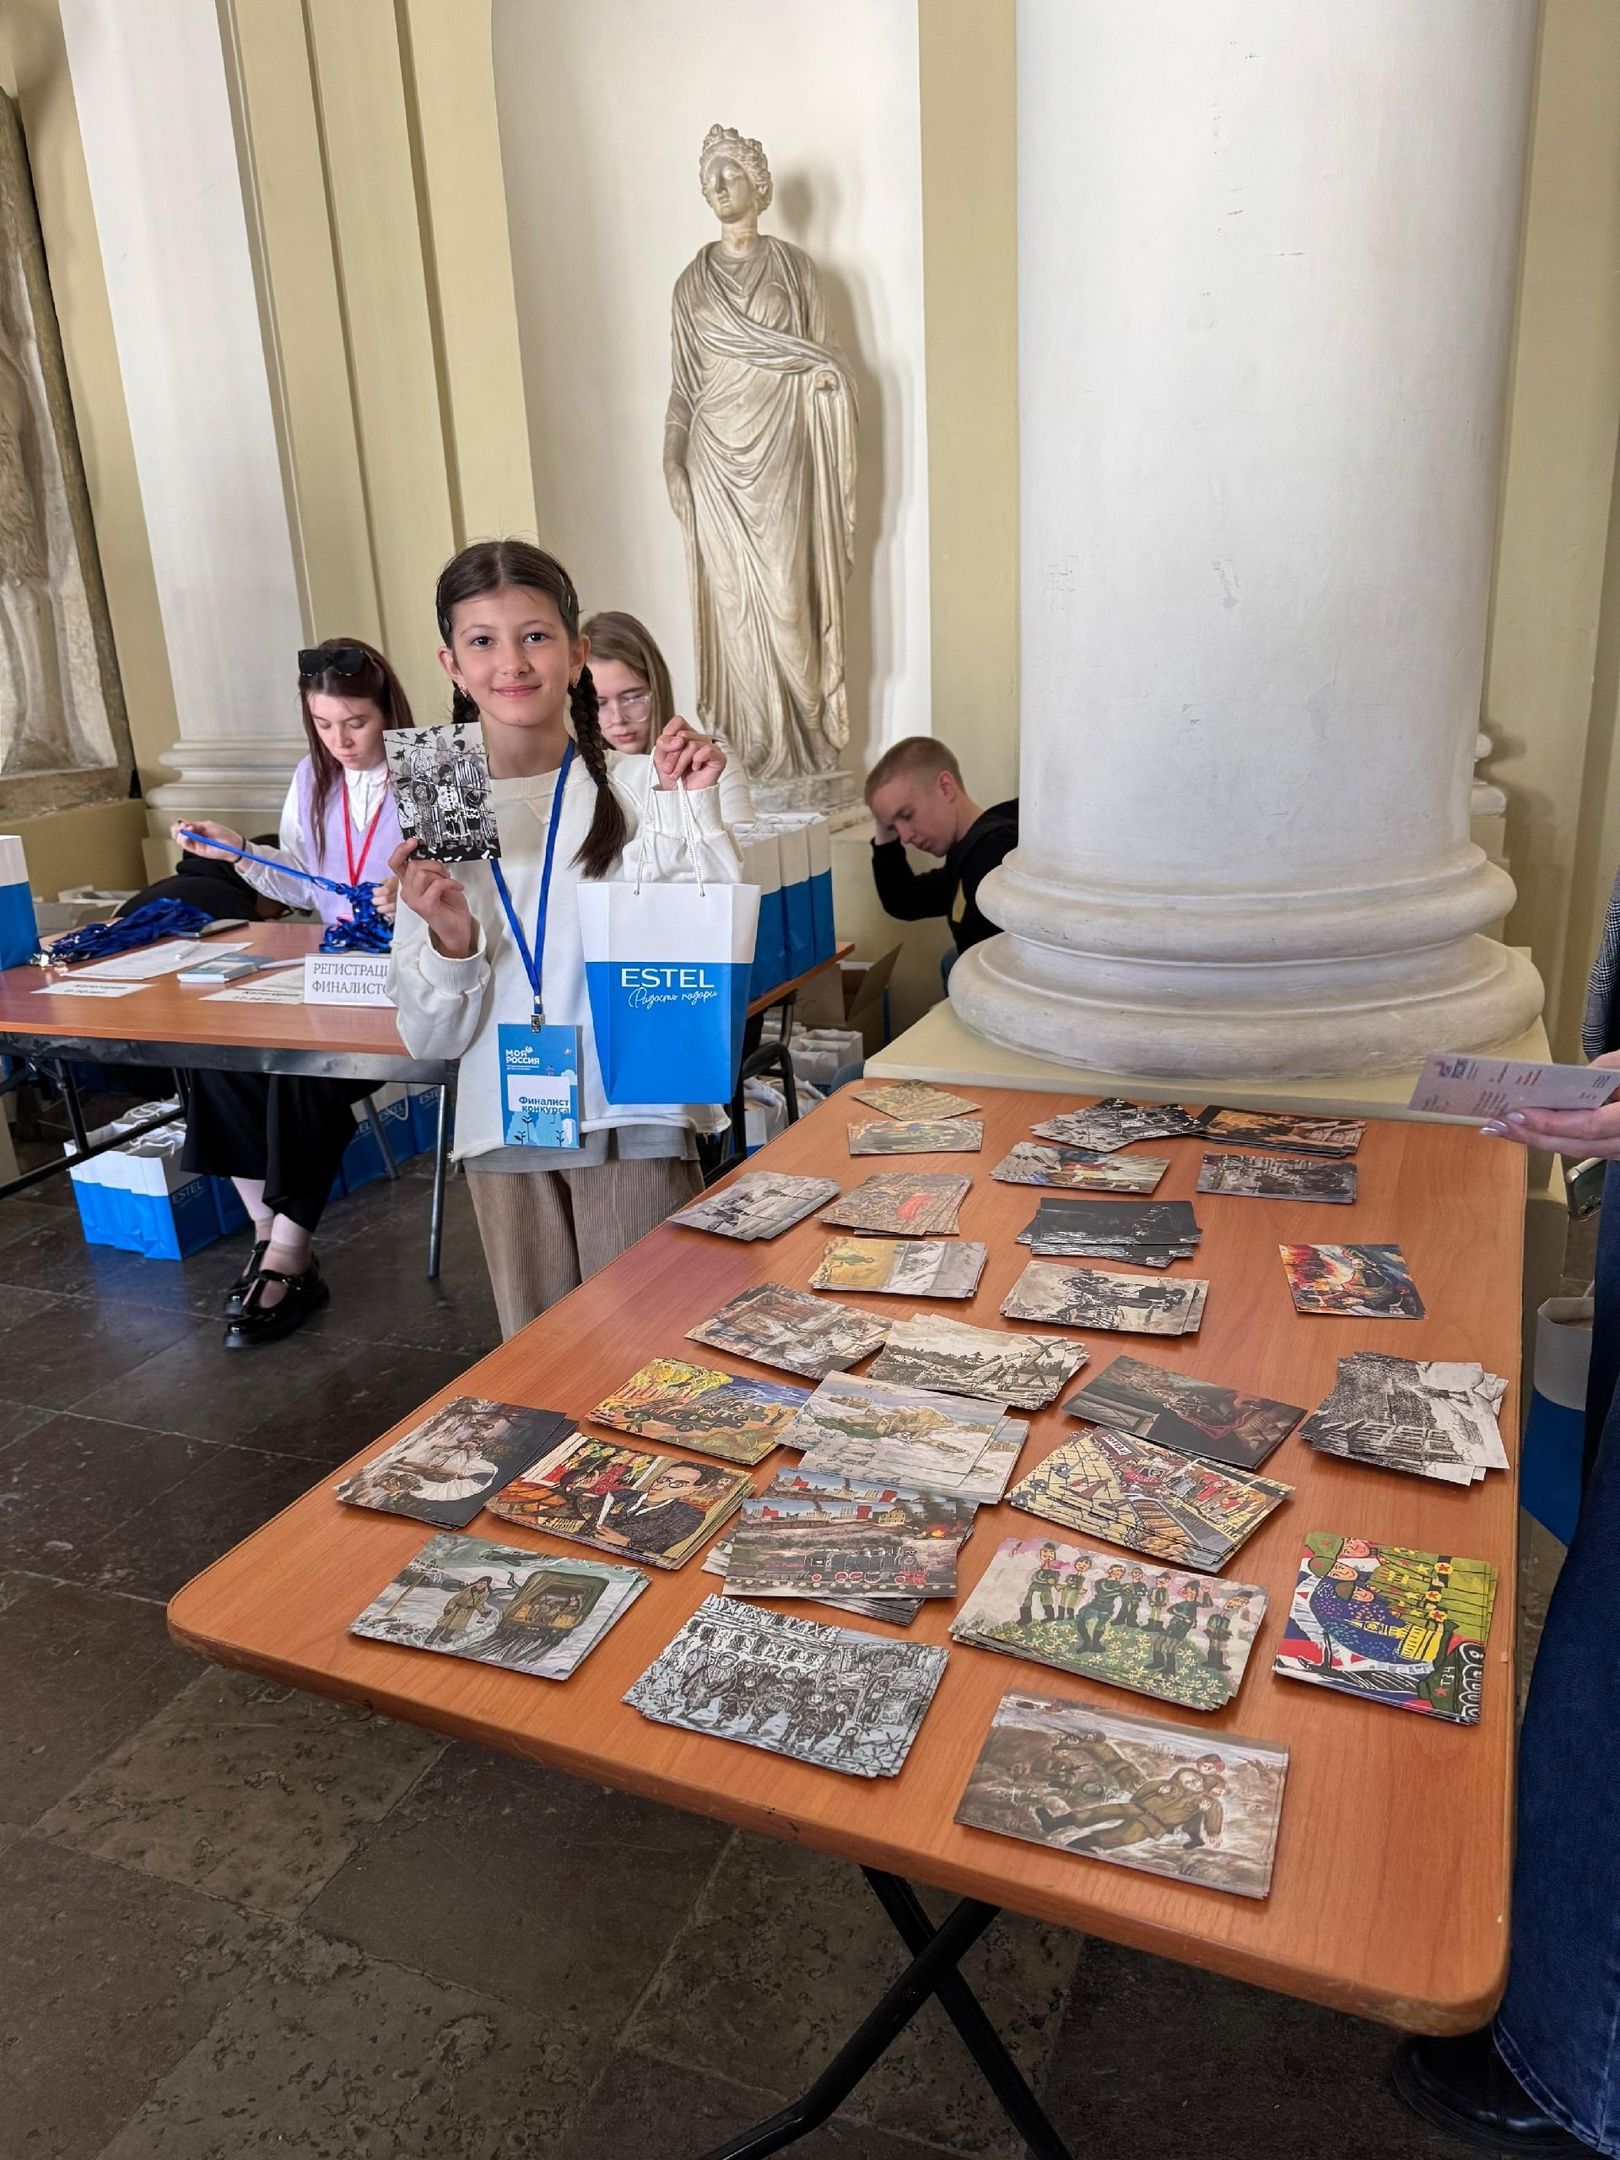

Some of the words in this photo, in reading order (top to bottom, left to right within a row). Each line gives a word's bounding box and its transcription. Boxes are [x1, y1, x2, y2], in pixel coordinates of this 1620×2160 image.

[621, 968, 715, 988] ESTEL
[506, 1049, 528, 1057] МОЯ
[506, 1056, 540, 1065] РОССИЯ
[518, 1096, 570, 1106] Финалист
[521, 1105, 570, 1115] конкурса
[172, 1180, 203, 1204] ESTEL
